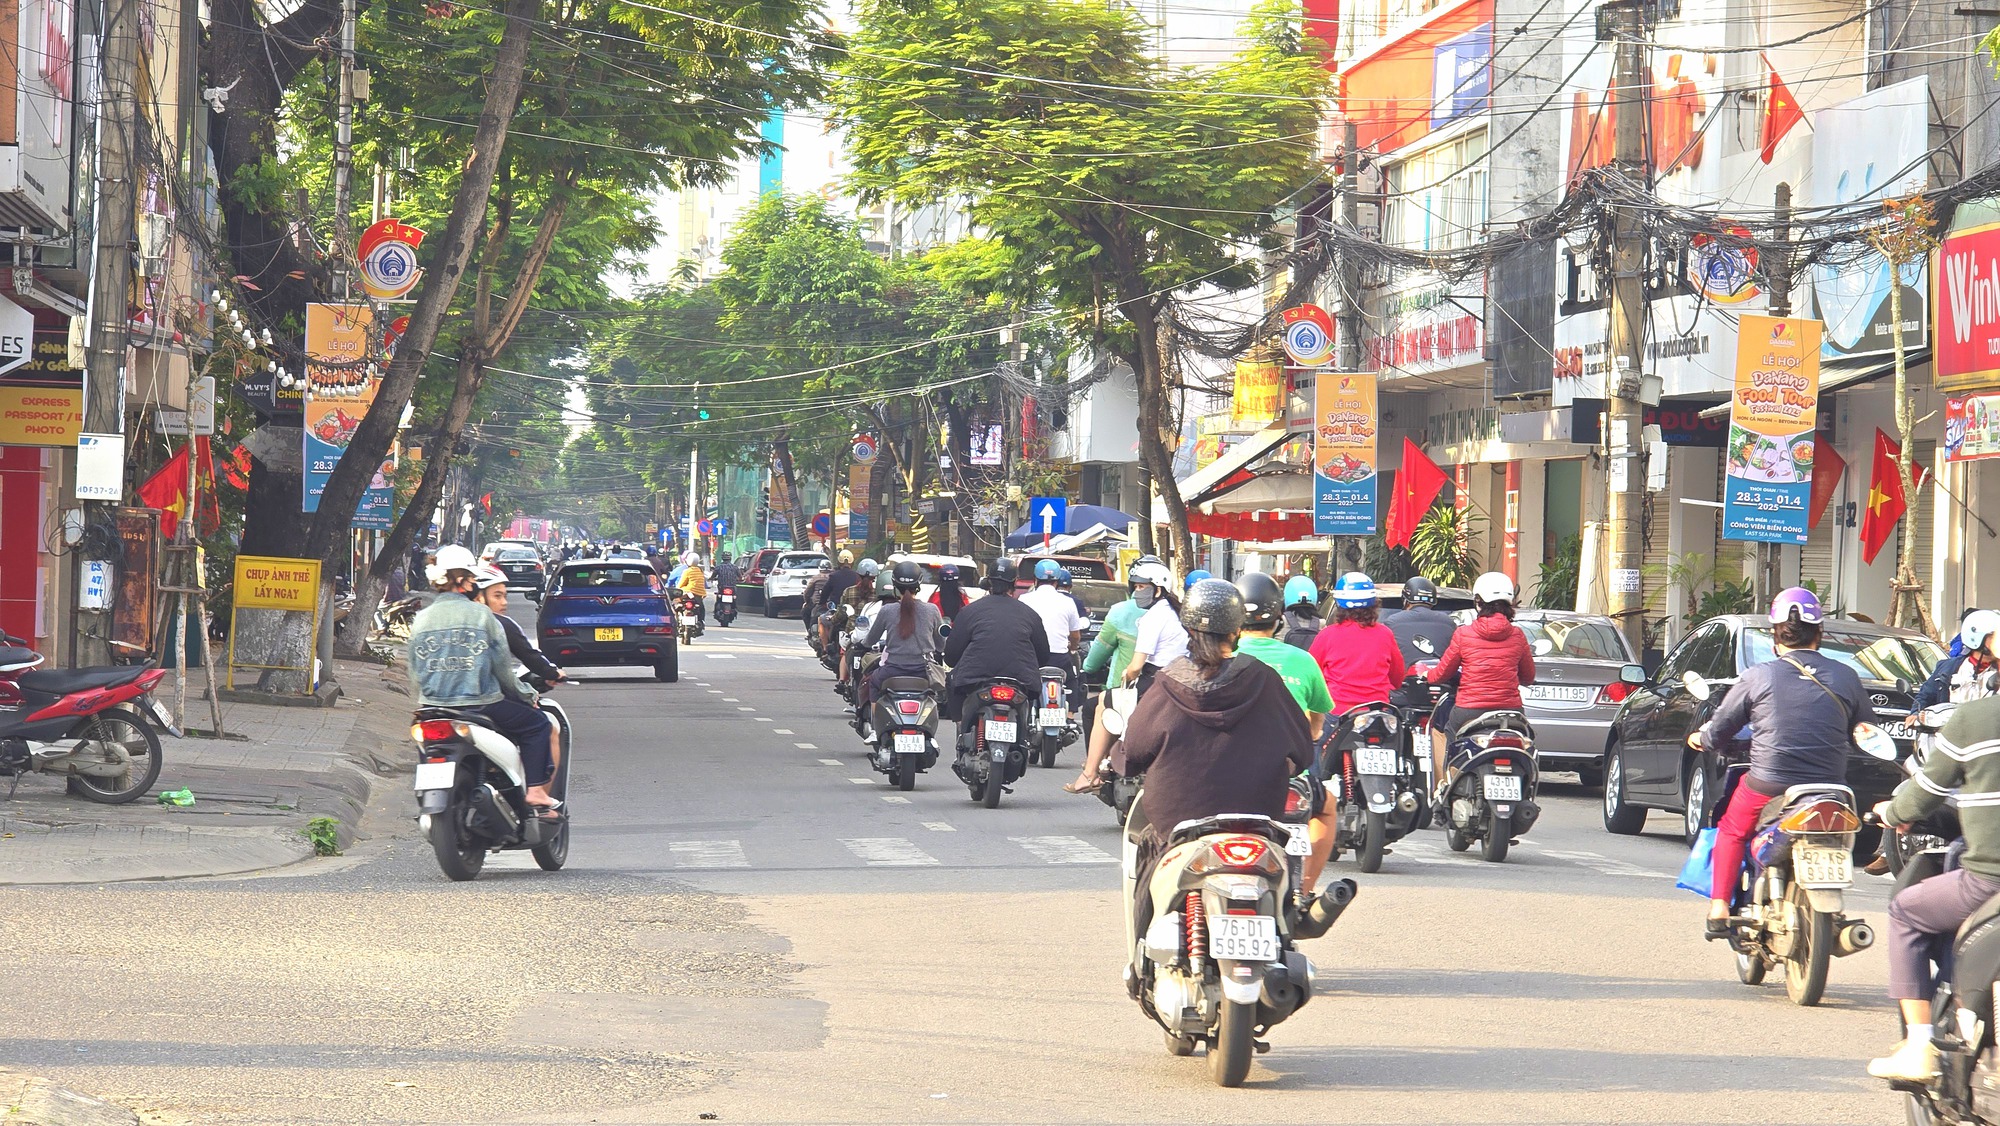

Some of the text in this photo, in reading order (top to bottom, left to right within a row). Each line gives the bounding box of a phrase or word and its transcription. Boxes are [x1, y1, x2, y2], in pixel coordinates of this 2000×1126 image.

[1762, 352, 1775, 365] LỄ
[1752, 370, 1809, 391] DaNang
[22, 397, 71, 407] EXPRESS
[1737, 386, 1816, 409] Food Tour
[1749, 404, 1782, 414] Festival
[5, 411, 64, 421] PASSPORT
[1328, 411, 1369, 425] DaNang
[25, 425, 65, 435] PHOTO
[1318, 422, 1347, 438] Food
[1349, 423, 1375, 437] Tour
[313, 461, 333, 470] 28.3
[1322, 493, 1340, 501] 28.3
[1351, 493, 1369, 501] 01.4
[1736, 492, 1761, 502] 28.3
[1776, 495, 1801, 506] 01.4
[1757, 503, 1779, 511] 2025
[1730, 521, 1749, 529] CÔNG
[1750, 522, 1766, 530] VIÊN
[91, 562, 102, 572] CS
[246, 566, 310, 582] CHỤP ẢNH THẺ
[91, 576, 102, 585] 47
[88, 587, 103, 598] HVT
[255, 583, 299, 600] LẤY NGAY
[599, 633, 619, 641] 101.21
[990, 721, 1012, 732] 29-E2
[899, 734, 920, 743] 43-AA
[987, 731, 1014, 742] 842.05
[1363, 750, 1389, 760] 43-C1
[1361, 761, 1394, 773] 495.92
[1490, 776, 1515, 787] 43-D1
[1486, 787, 1520, 798] 393.39
[1221, 918, 1263, 937] 76-D1
[1215, 937, 1271, 957] 595.92
